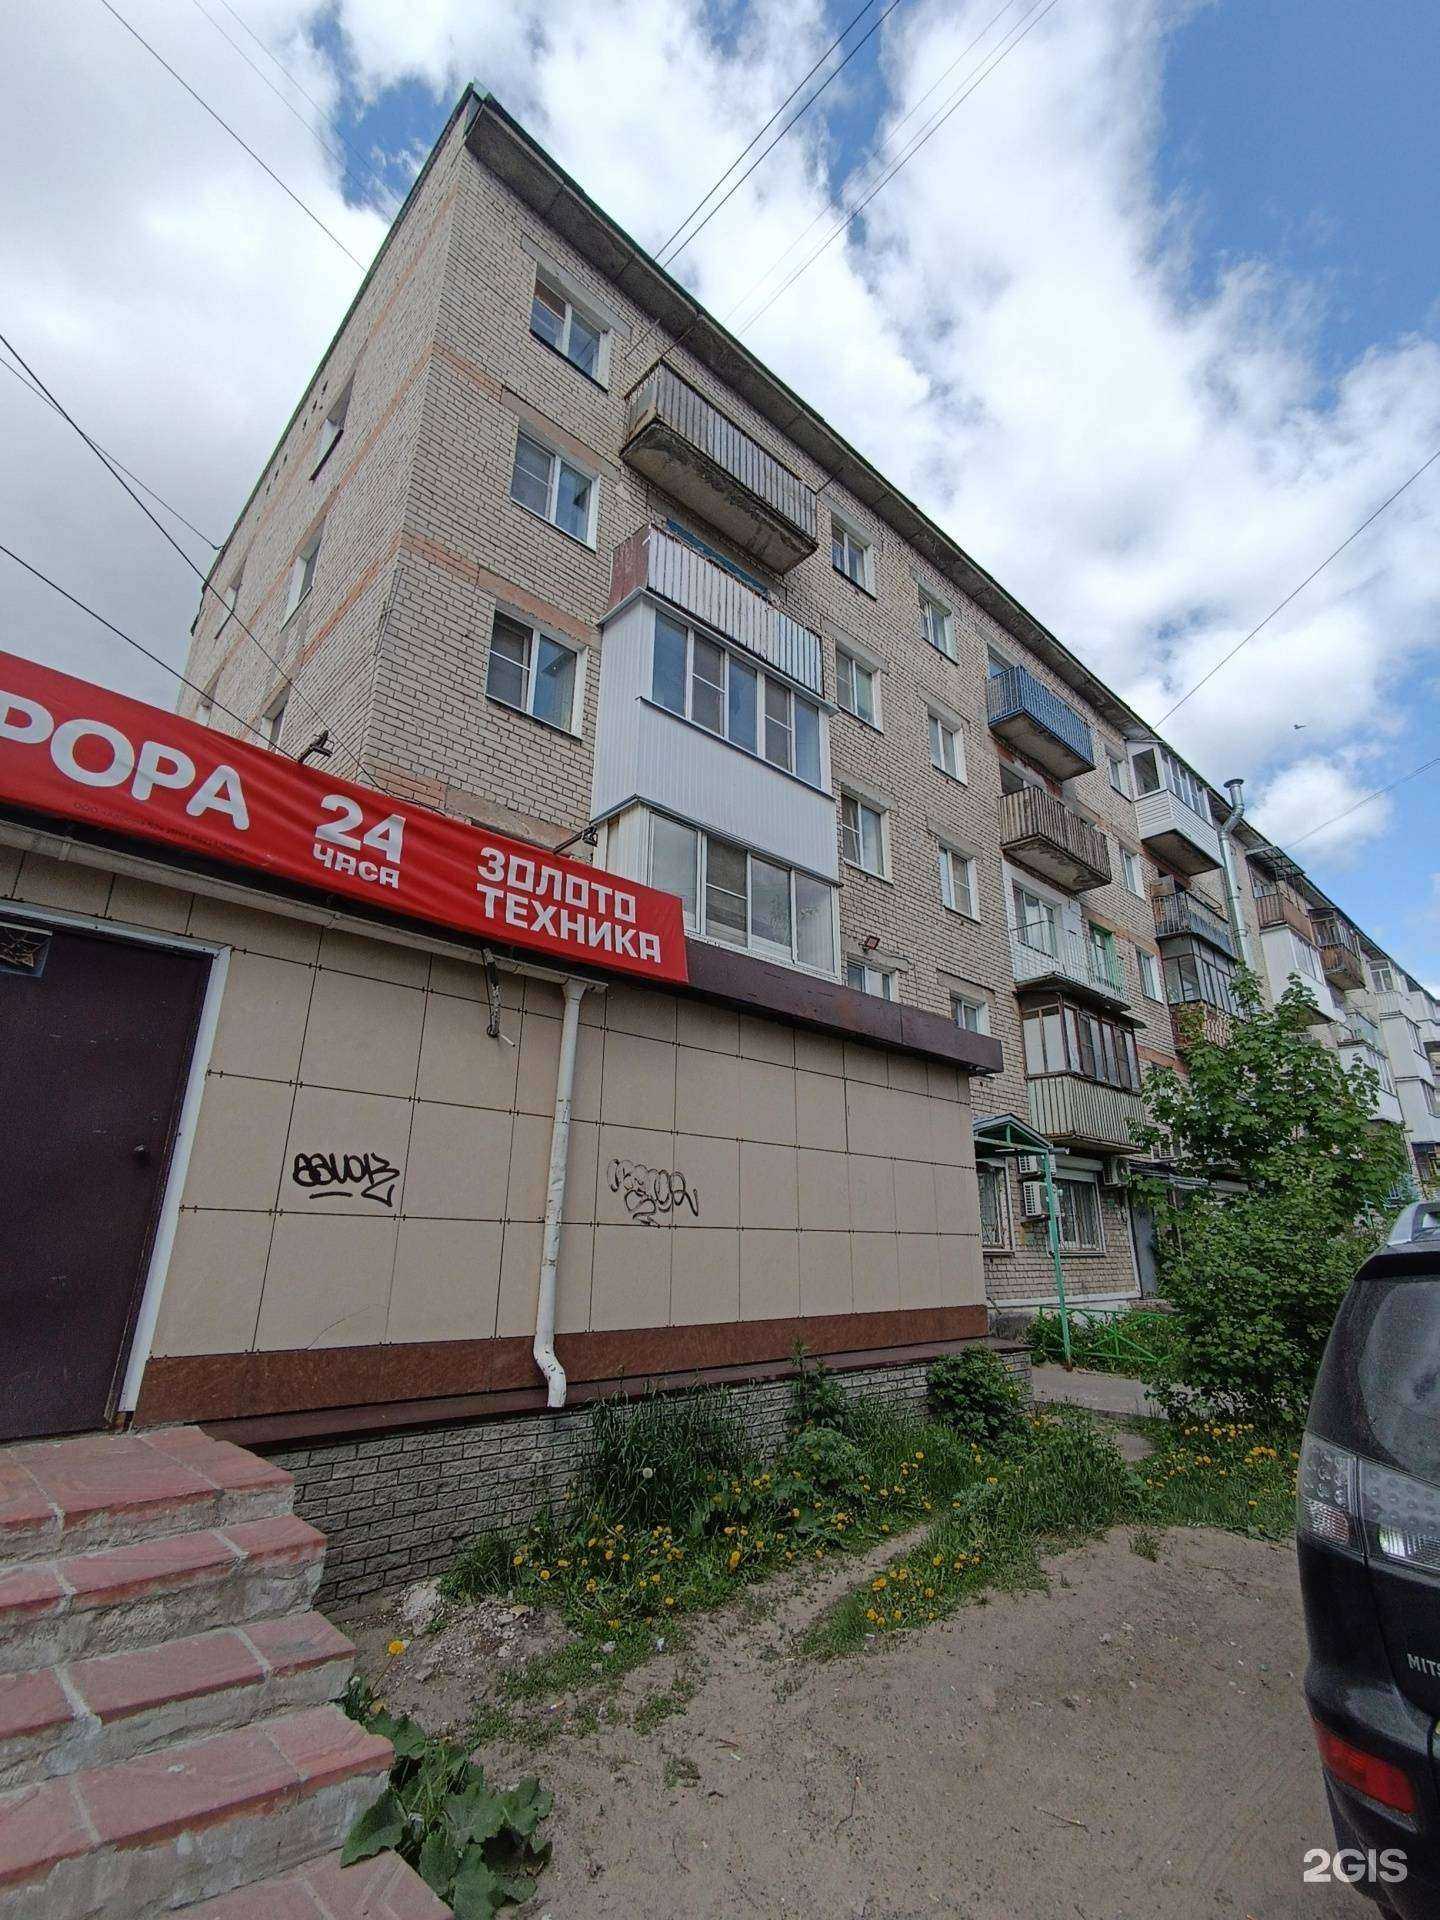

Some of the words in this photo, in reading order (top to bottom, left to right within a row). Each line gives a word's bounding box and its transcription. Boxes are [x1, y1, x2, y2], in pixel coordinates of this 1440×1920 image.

[313, 843, 400, 889] ЧАСА
[315, 794, 406, 864] 24
[477, 846, 637, 924] ЗОЛОТО
[476, 883, 662, 964] ТЕХНИКА
